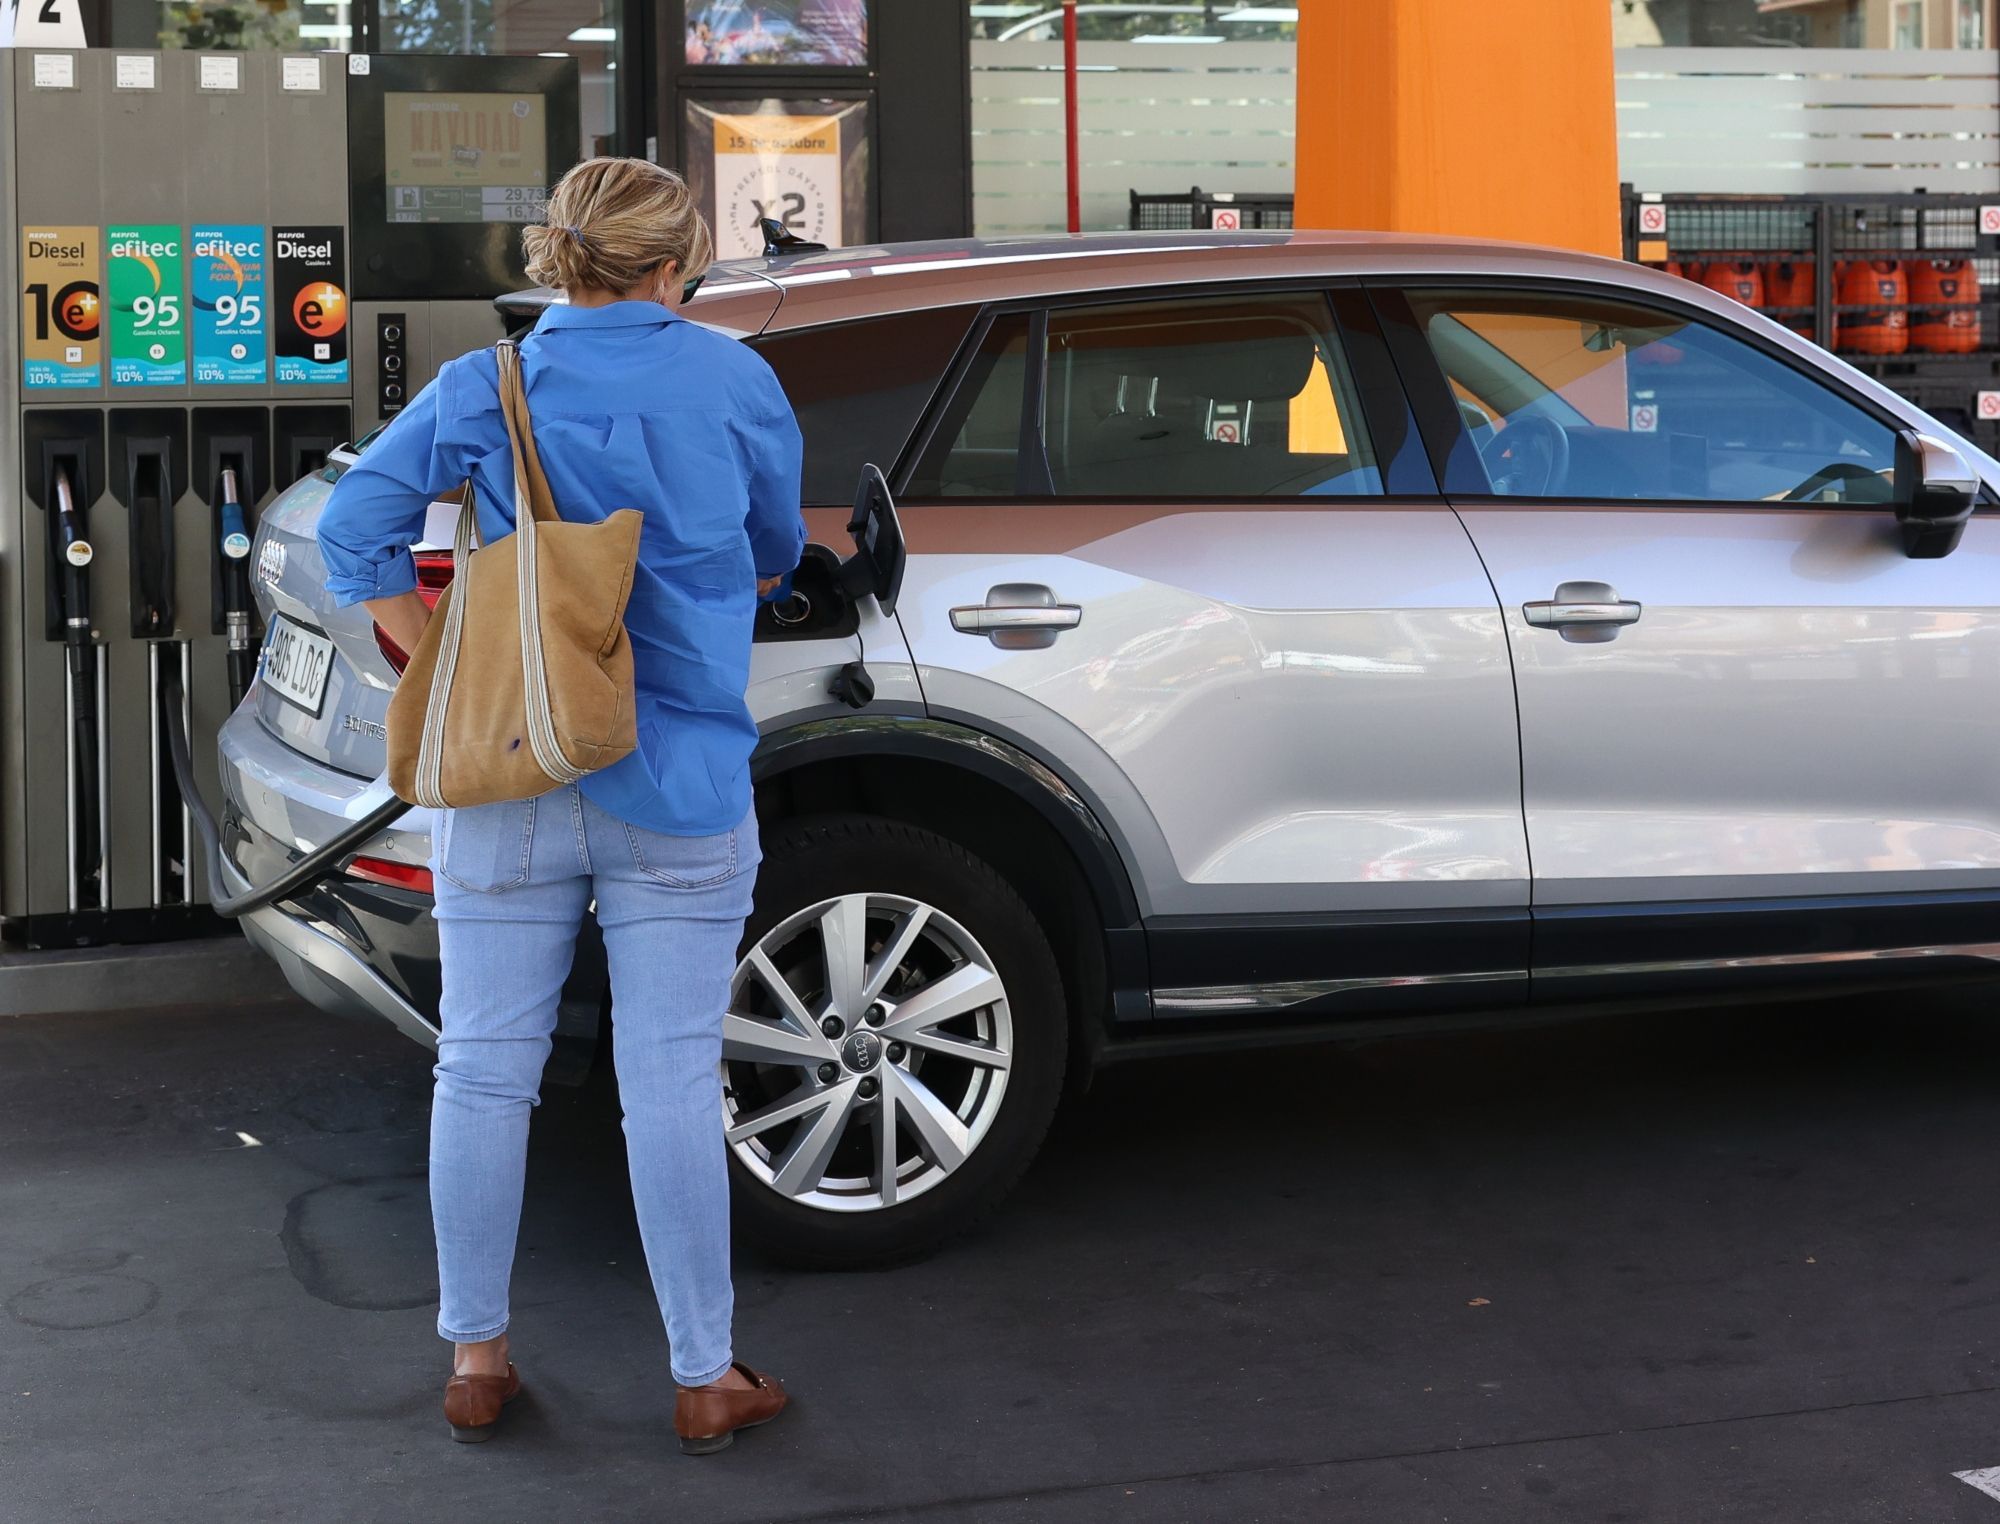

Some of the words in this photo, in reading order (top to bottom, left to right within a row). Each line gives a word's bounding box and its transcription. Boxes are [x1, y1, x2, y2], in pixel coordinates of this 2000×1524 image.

[729, 136, 745, 148] 15
[772, 136, 825, 149] octubre
[505, 188, 544, 201] 29,73
[506, 205, 544, 220] 16,7
[729, 202, 760, 256] MULTIPLIC
[29, 241, 84, 258] Diesel
[111, 240, 178, 258] efitec
[195, 240, 261, 258] efitec
[277, 240, 331, 258] Diesel
[133, 295, 179, 327] 95
[215, 295, 261, 327] 95
[29, 372, 57, 384] 10%
[116, 371, 144, 382] 10%
[198, 369, 225, 381] 10%
[279, 369, 306, 381] 10%
[291, 640, 324, 699] LDG
[362, 720, 388, 743] TFS
